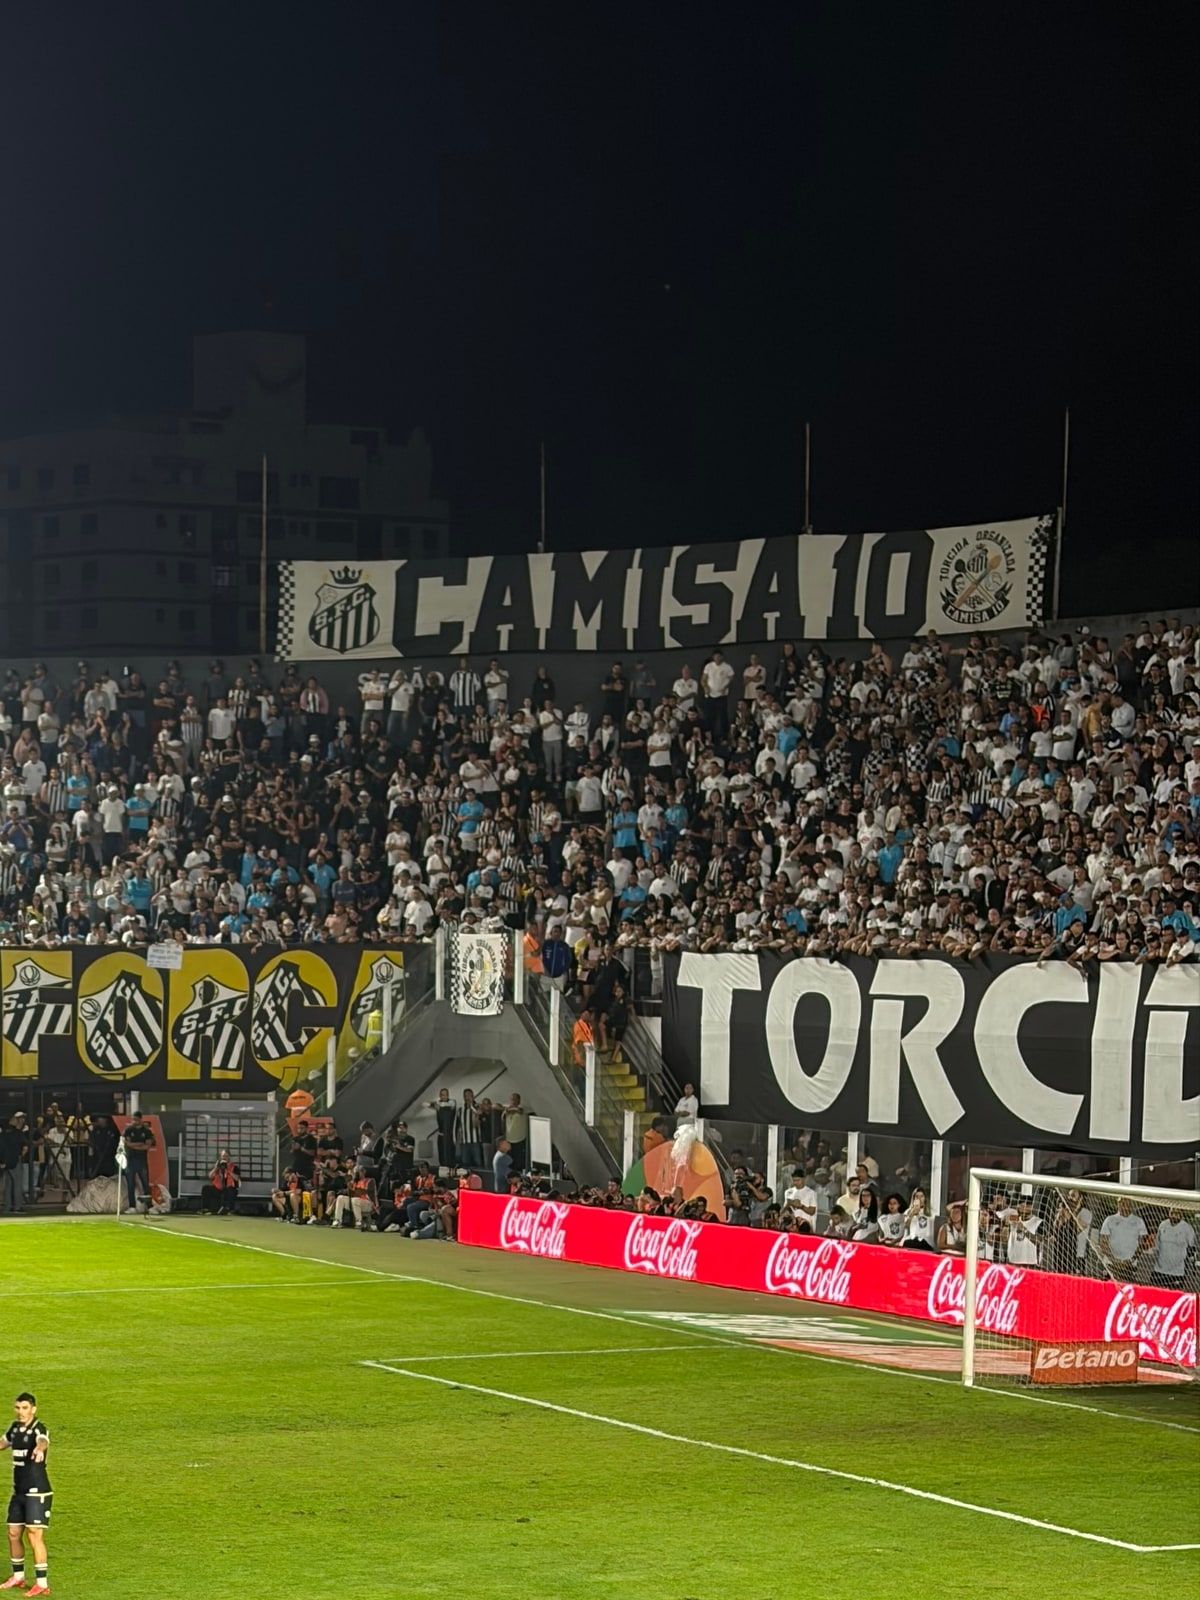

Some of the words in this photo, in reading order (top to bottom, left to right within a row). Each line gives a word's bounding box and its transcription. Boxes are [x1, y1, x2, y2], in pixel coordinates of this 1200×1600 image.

[940, 537, 969, 582] TORCIDA
[392, 534, 802, 657] CAMISA
[826, 530, 934, 639] 10
[945, 605, 990, 623] CAMISA
[991, 600, 1004, 615] 10
[1035, 1348, 1136, 1369] Betano
